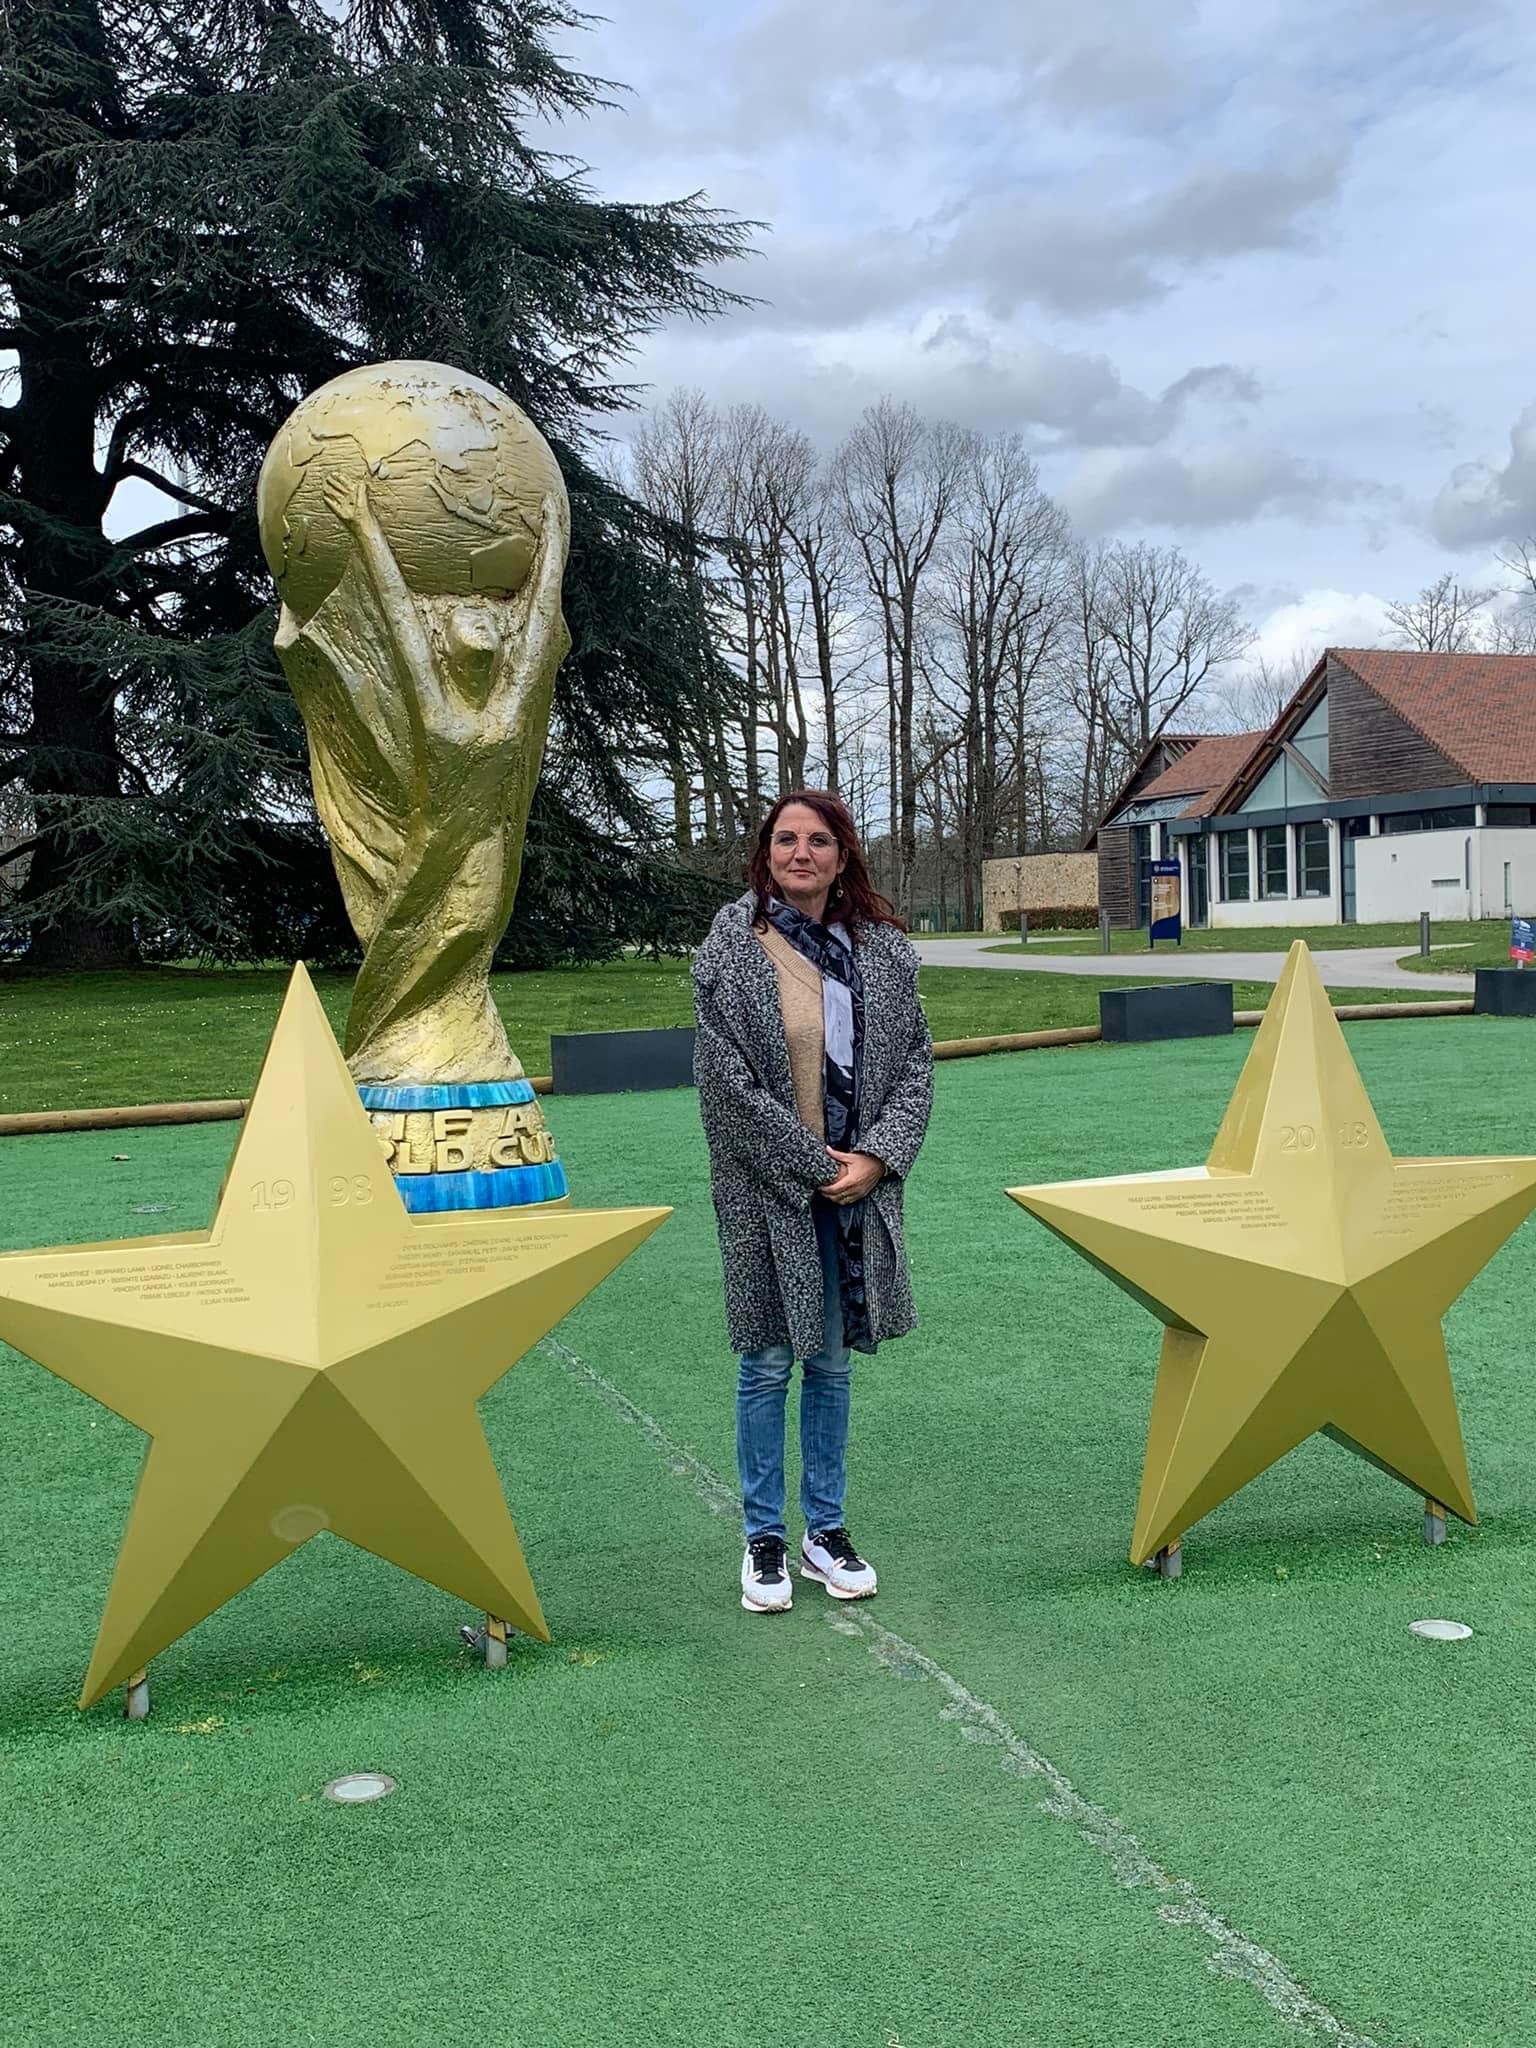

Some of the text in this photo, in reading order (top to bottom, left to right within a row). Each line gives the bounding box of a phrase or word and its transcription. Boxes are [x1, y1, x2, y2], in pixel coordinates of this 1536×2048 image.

[370, 1108, 538, 1141] IFA
[490, 1131, 555, 1166] CUP
[250, 1178, 296, 1212] 19
